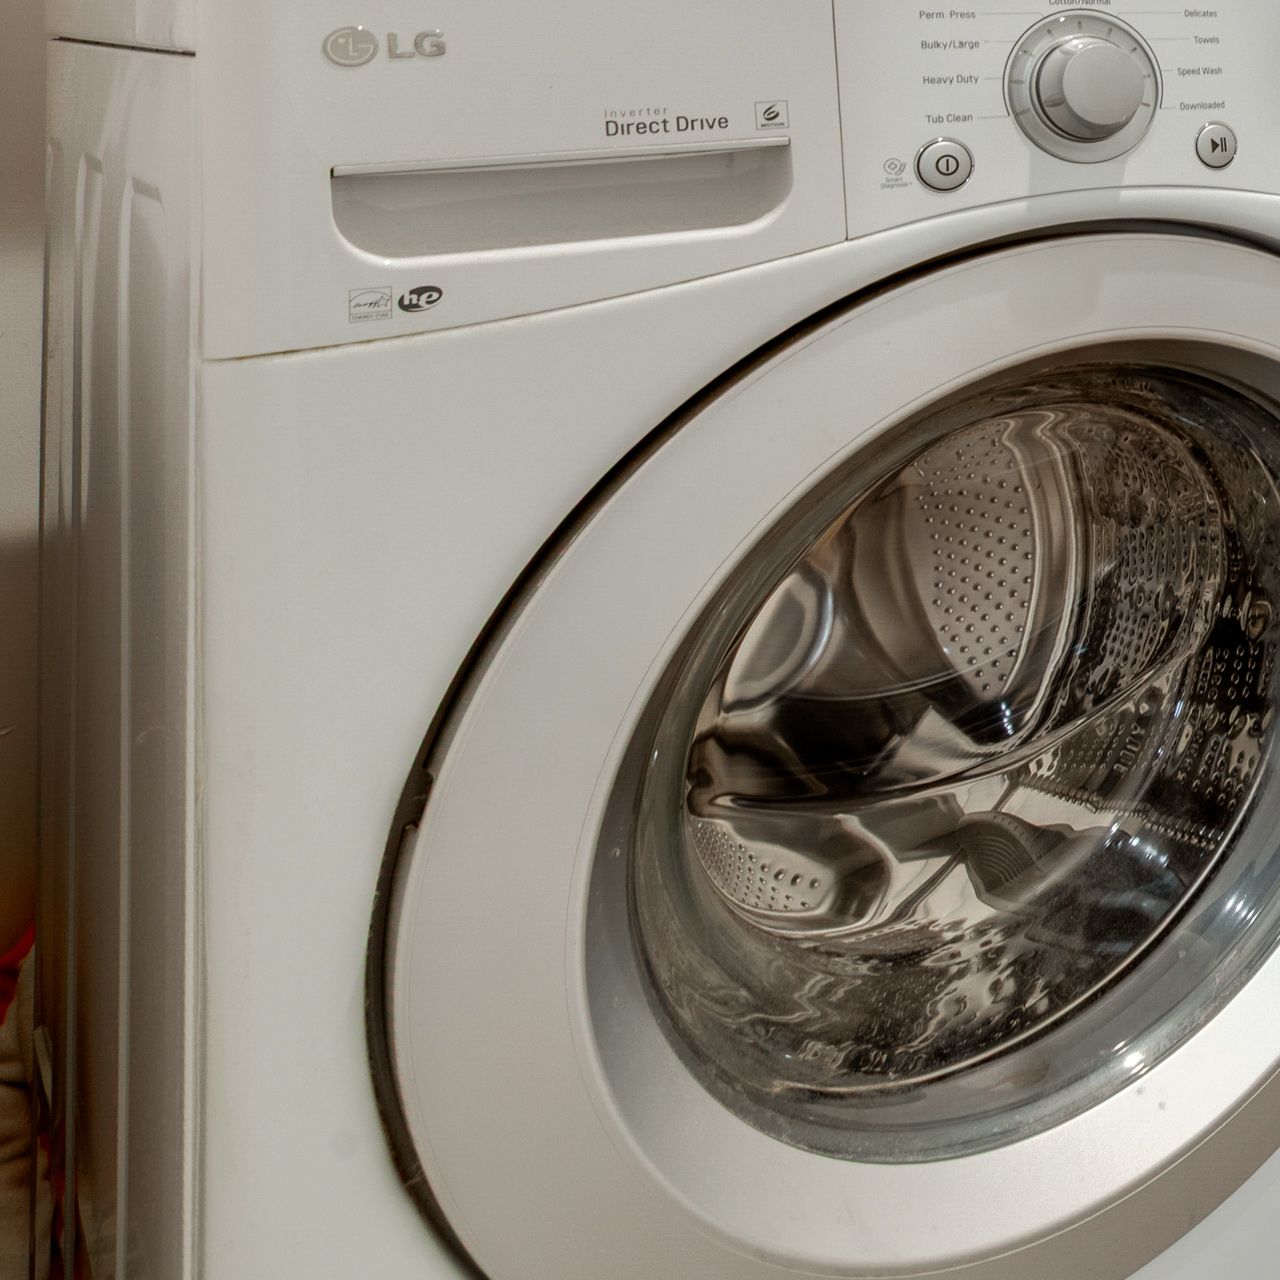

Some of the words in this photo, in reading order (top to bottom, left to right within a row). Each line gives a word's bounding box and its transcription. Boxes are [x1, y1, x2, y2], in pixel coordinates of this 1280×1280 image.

[949, 10, 976, 20] Press
[1184, 9, 1218, 19] Delicates
[387, 30, 447, 60] LG
[921, 40, 980, 50] Bulky/Large
[1194, 35, 1220, 45] Towels
[1177, 67, 1199, 77] Speed
[1202, 66, 1223, 76] Wash
[922, 75, 954, 86] Heavy
[956, 74, 979, 85] Duty
[1179, 101, 1226, 112] Downloaded
[604, 108, 669, 119] Inverter
[926, 114, 945, 124] Tub
[946, 113, 973, 123] Clean
[605, 118, 670, 138] Direct
[675, 115, 730, 133] Drive
